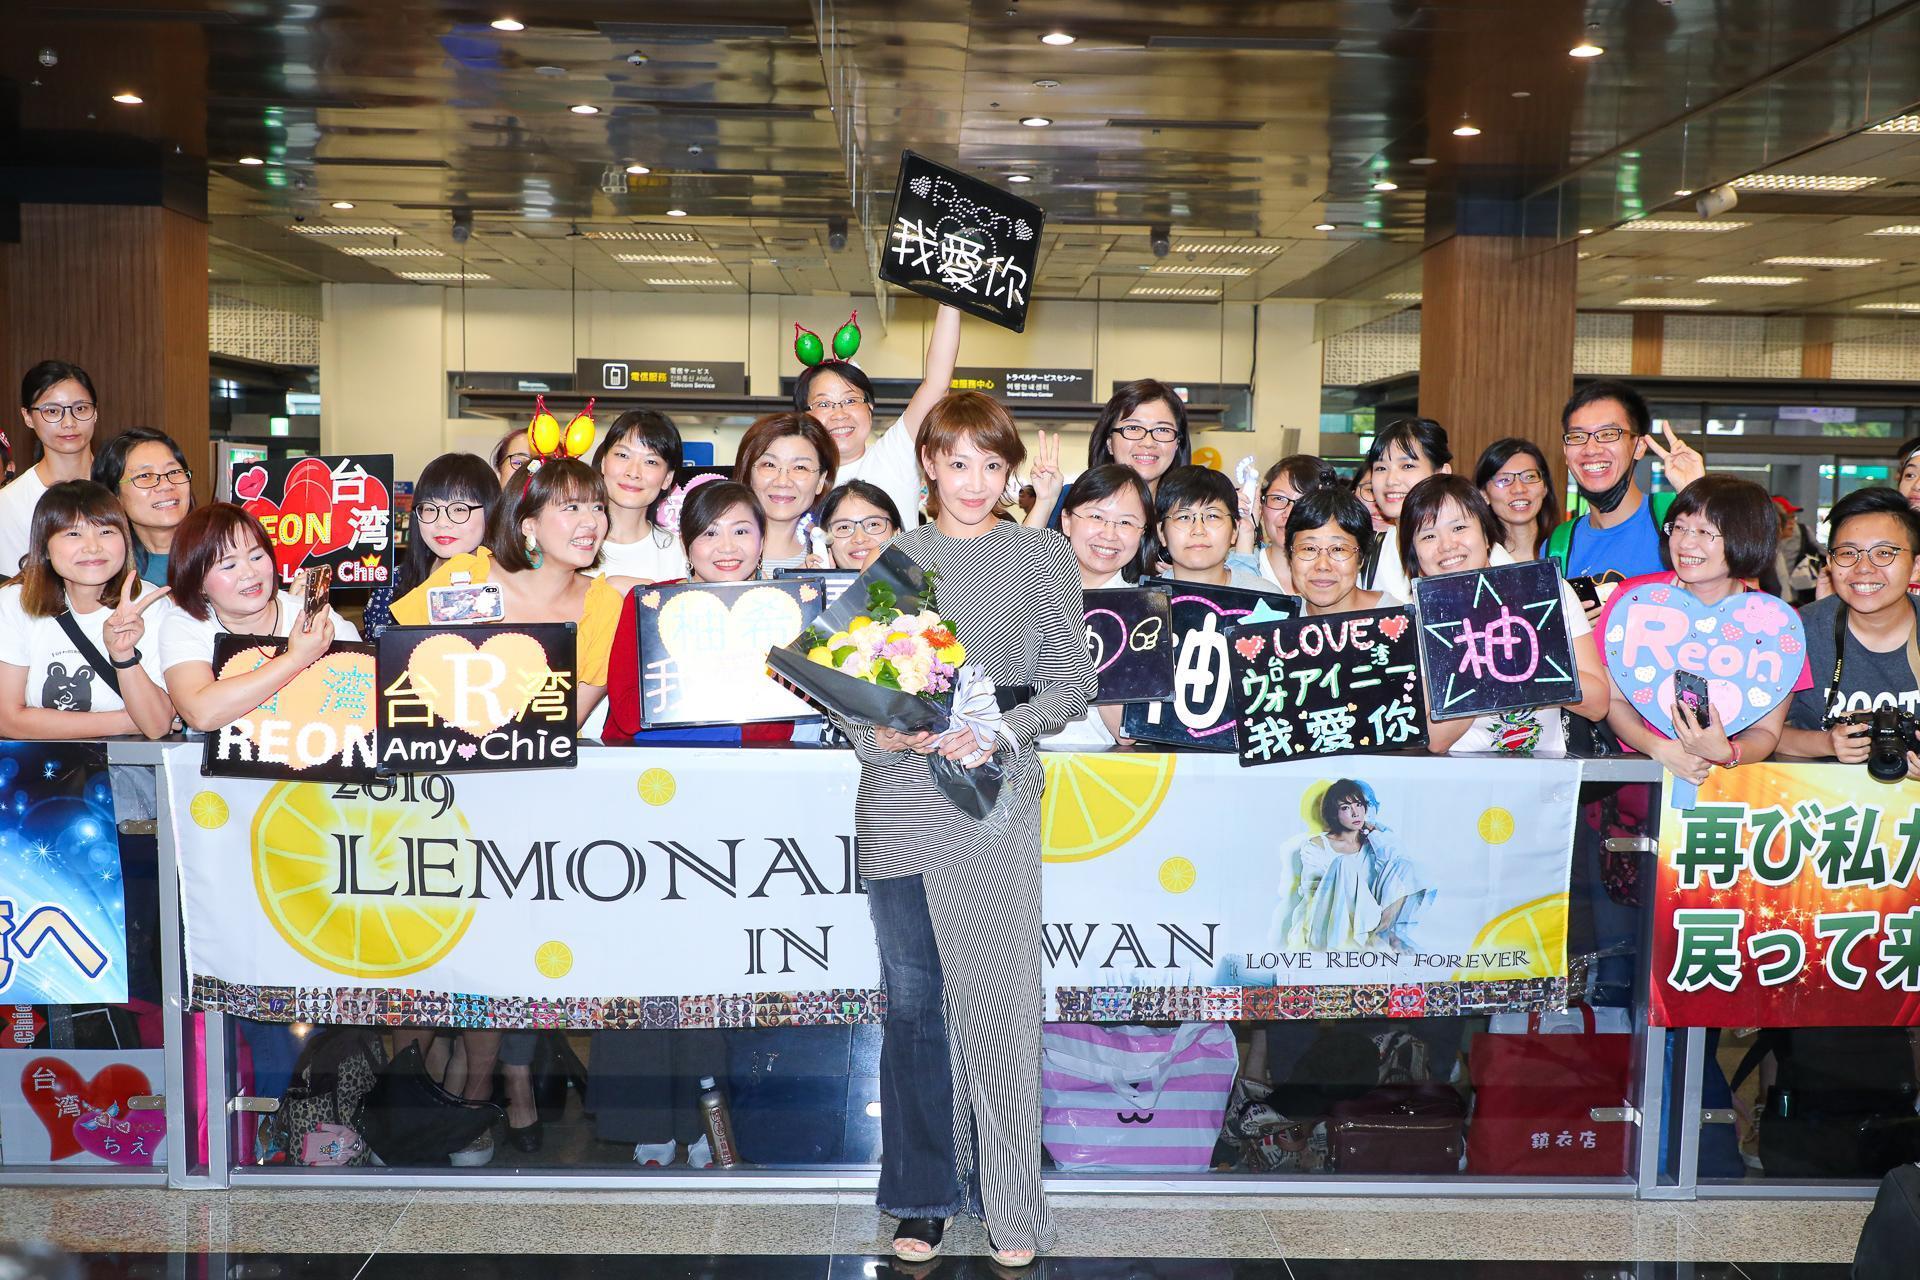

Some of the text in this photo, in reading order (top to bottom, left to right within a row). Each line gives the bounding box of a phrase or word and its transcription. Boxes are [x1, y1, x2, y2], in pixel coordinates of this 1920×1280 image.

[891, 216, 1027, 309] 我愛你
[630, 371, 668, 383] 電信服務
[259, 512, 332, 547] EON
[337, 560, 389, 583] Chie
[1273, 617, 1376, 660] LOVE
[1453, 605, 1540, 683] 柚
[1622, 603, 1783, 684] Reon
[216, 718, 378, 769] REON
[383, 737, 457, 765] Amy
[1247, 698, 1421, 761] 我愛你
[744, 922, 1221, 976] IN WAN
[1245, 949, 1531, 970] LOVE REON FOREVER
